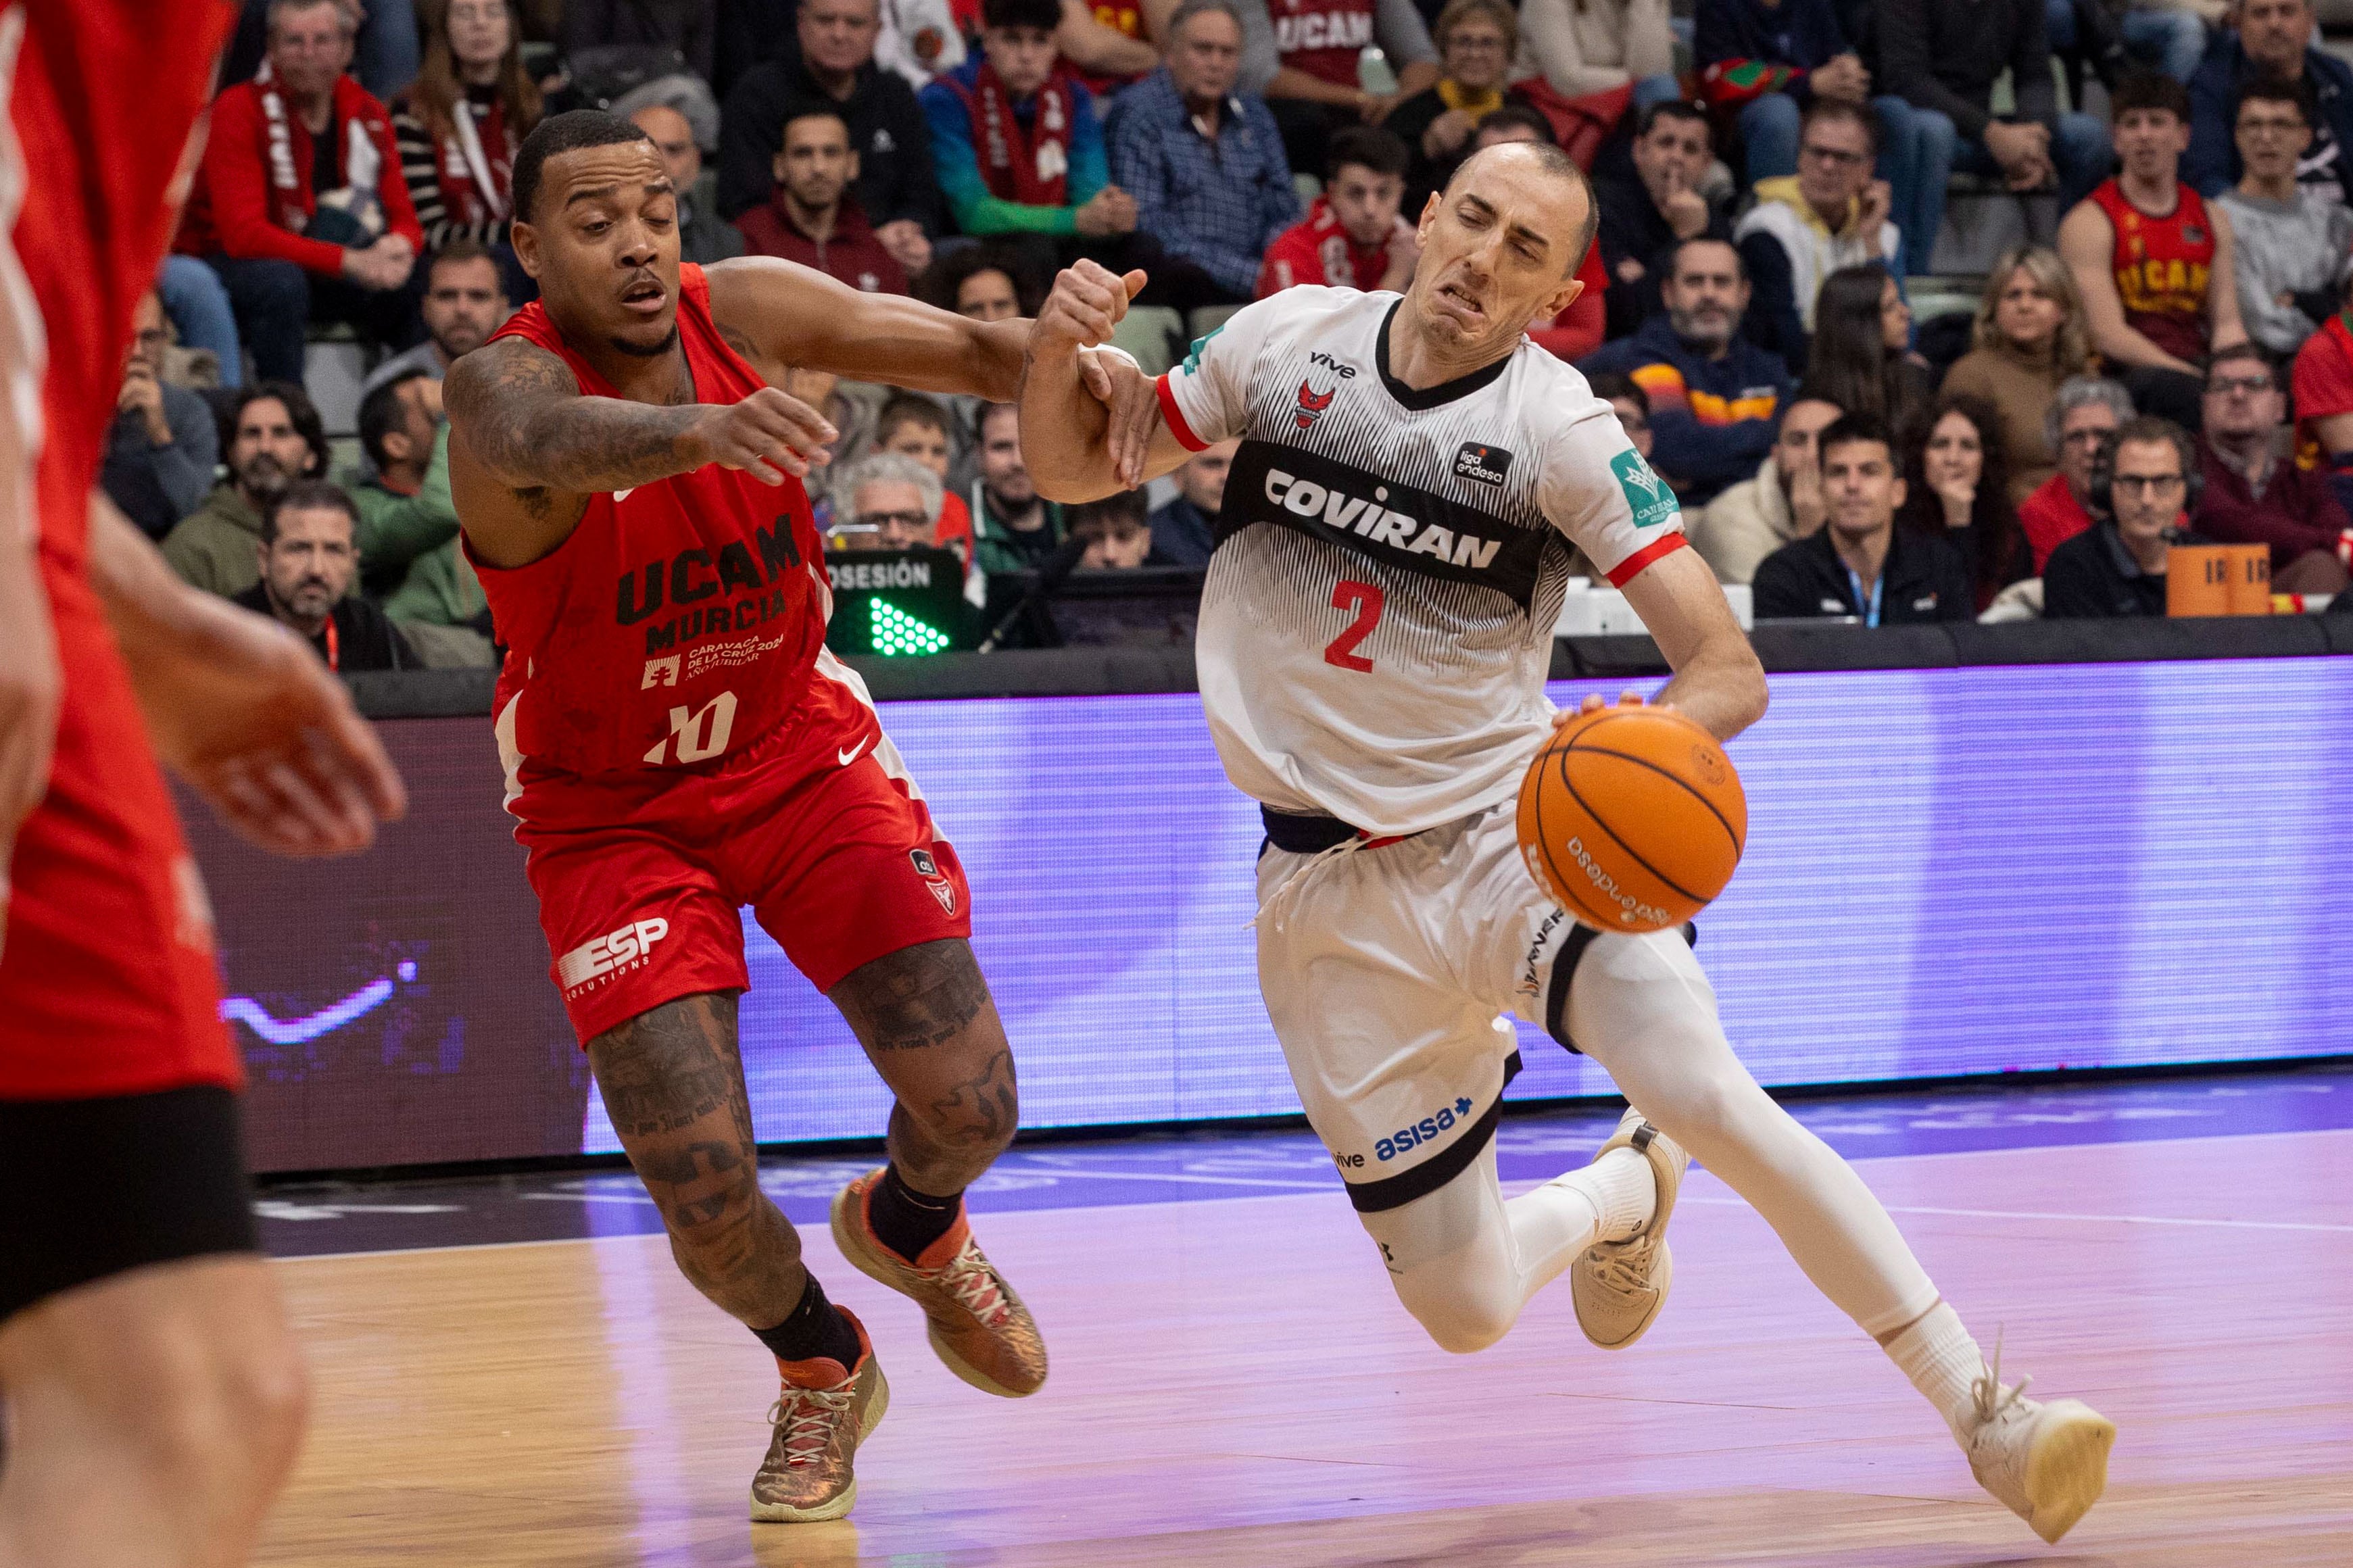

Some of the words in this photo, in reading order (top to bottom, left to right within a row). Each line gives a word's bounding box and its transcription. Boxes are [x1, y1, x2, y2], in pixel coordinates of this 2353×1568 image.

[1310, 351, 1357, 379] vive
[1457, 463, 1503, 483] endesa
[1460, 450, 1482, 465] liga
[616, 513, 801, 627] UCAM
[825, 557, 931, 589] OSESIÓN
[646, 589, 786, 655] MURCIA
[1325, 579, 1384, 674] 2
[687, 658, 702, 670] DE
[705, 653, 719, 664] LA
[721, 645, 754, 658] CRUZ
[689, 635, 760, 659] CARAVACA
[685, 664, 710, 681] AÑO
[710, 652, 760, 670] JUBILAR
[644, 690, 738, 764] 10
[560, 916, 669, 989] ESP
[566, 956, 650, 1002] SOLUTIONS
[1374, 1107, 1456, 1162] asisa
[1332, 1152, 1365, 1169] vive
